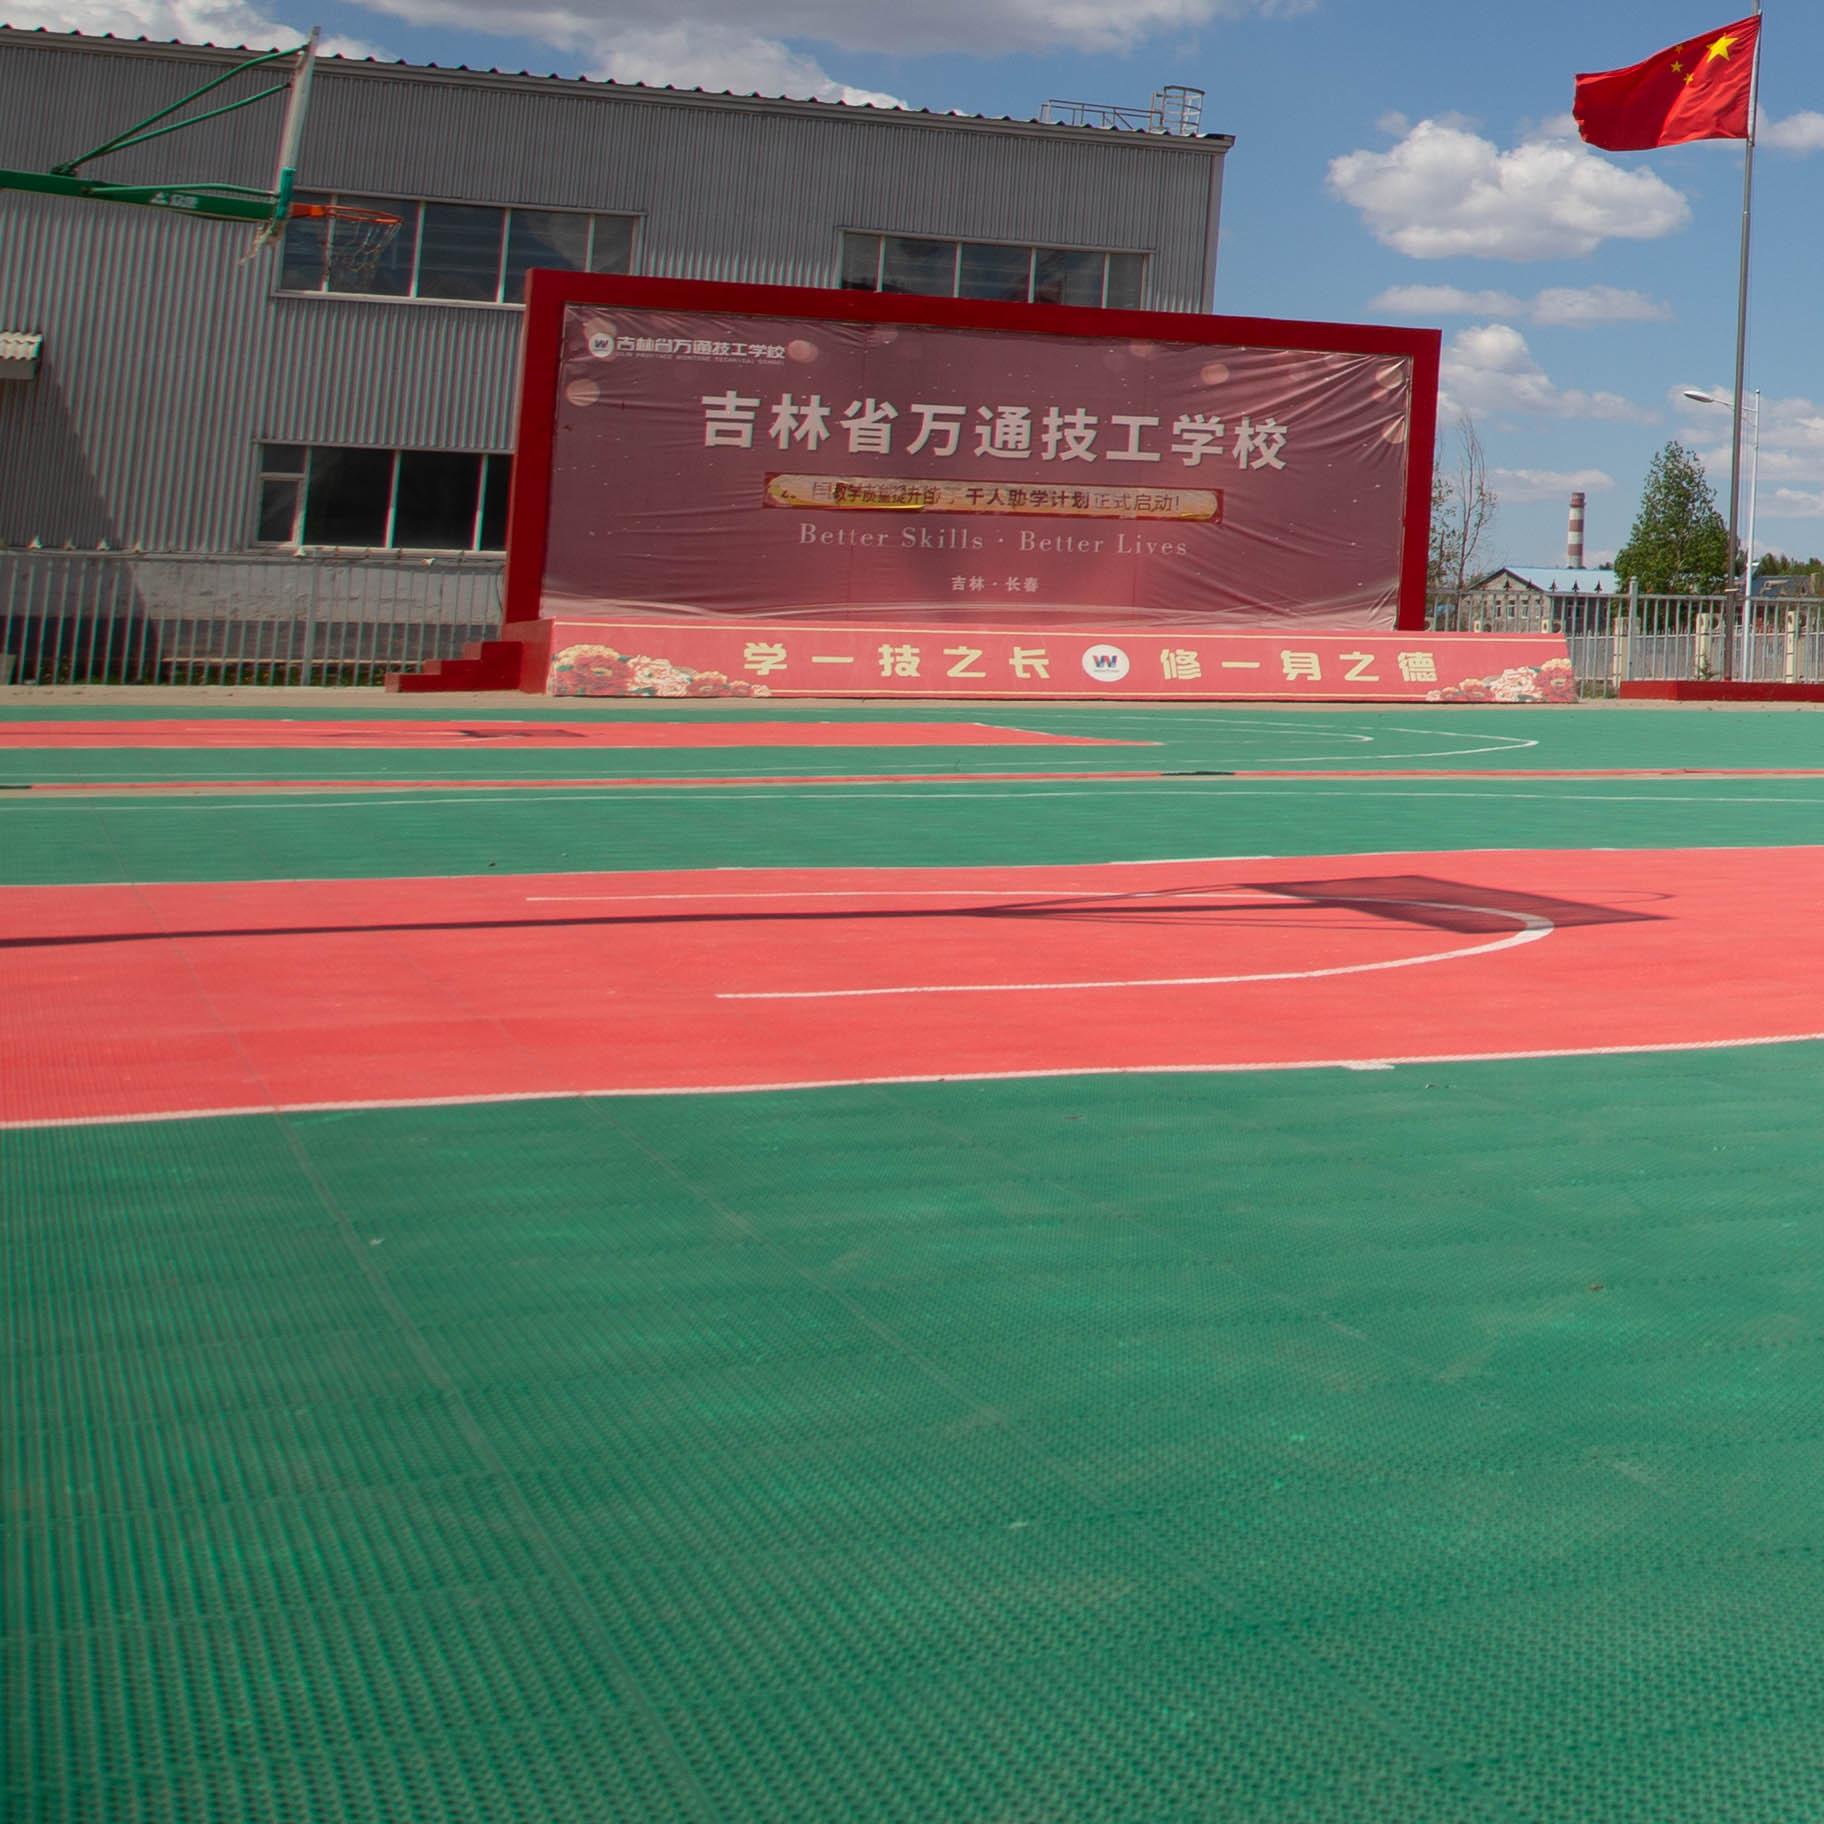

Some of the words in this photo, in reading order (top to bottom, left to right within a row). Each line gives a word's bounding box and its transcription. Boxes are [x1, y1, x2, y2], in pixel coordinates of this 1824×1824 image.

[616, 336, 785, 358] 吉林省万通技工学校
[700, 390, 1289, 470] 吉林省万通技工学校
[800, 524, 889, 546] Better
[902, 527, 984, 550] Skills
[1020, 530, 1105, 553] Better
[1117, 534, 1188, 556] Lives
[743, 642, 1050, 679] 学一技之长
[1160, 648, 1438, 683] 修一身之德
